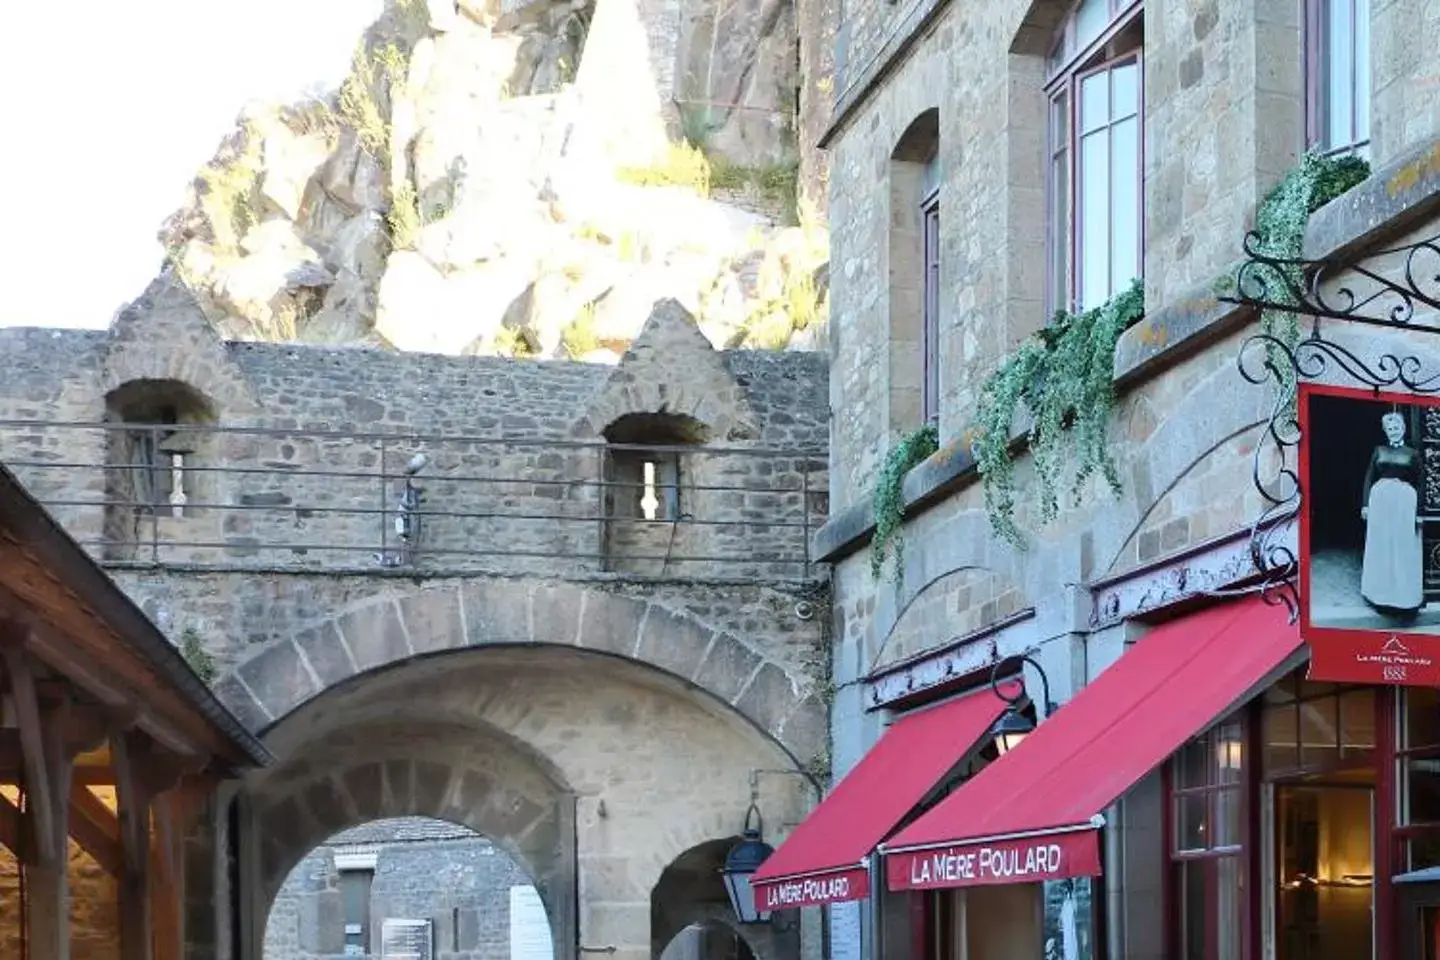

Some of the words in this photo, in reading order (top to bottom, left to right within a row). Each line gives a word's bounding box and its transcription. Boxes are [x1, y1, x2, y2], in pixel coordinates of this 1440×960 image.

[911, 856, 931, 884] LA
[932, 848, 976, 881] MÈRE
[979, 844, 1061, 877] POULARD
[767, 886, 779, 906] LA
[779, 881, 802, 903] MÈRE
[802, 877, 849, 902] POULARD
